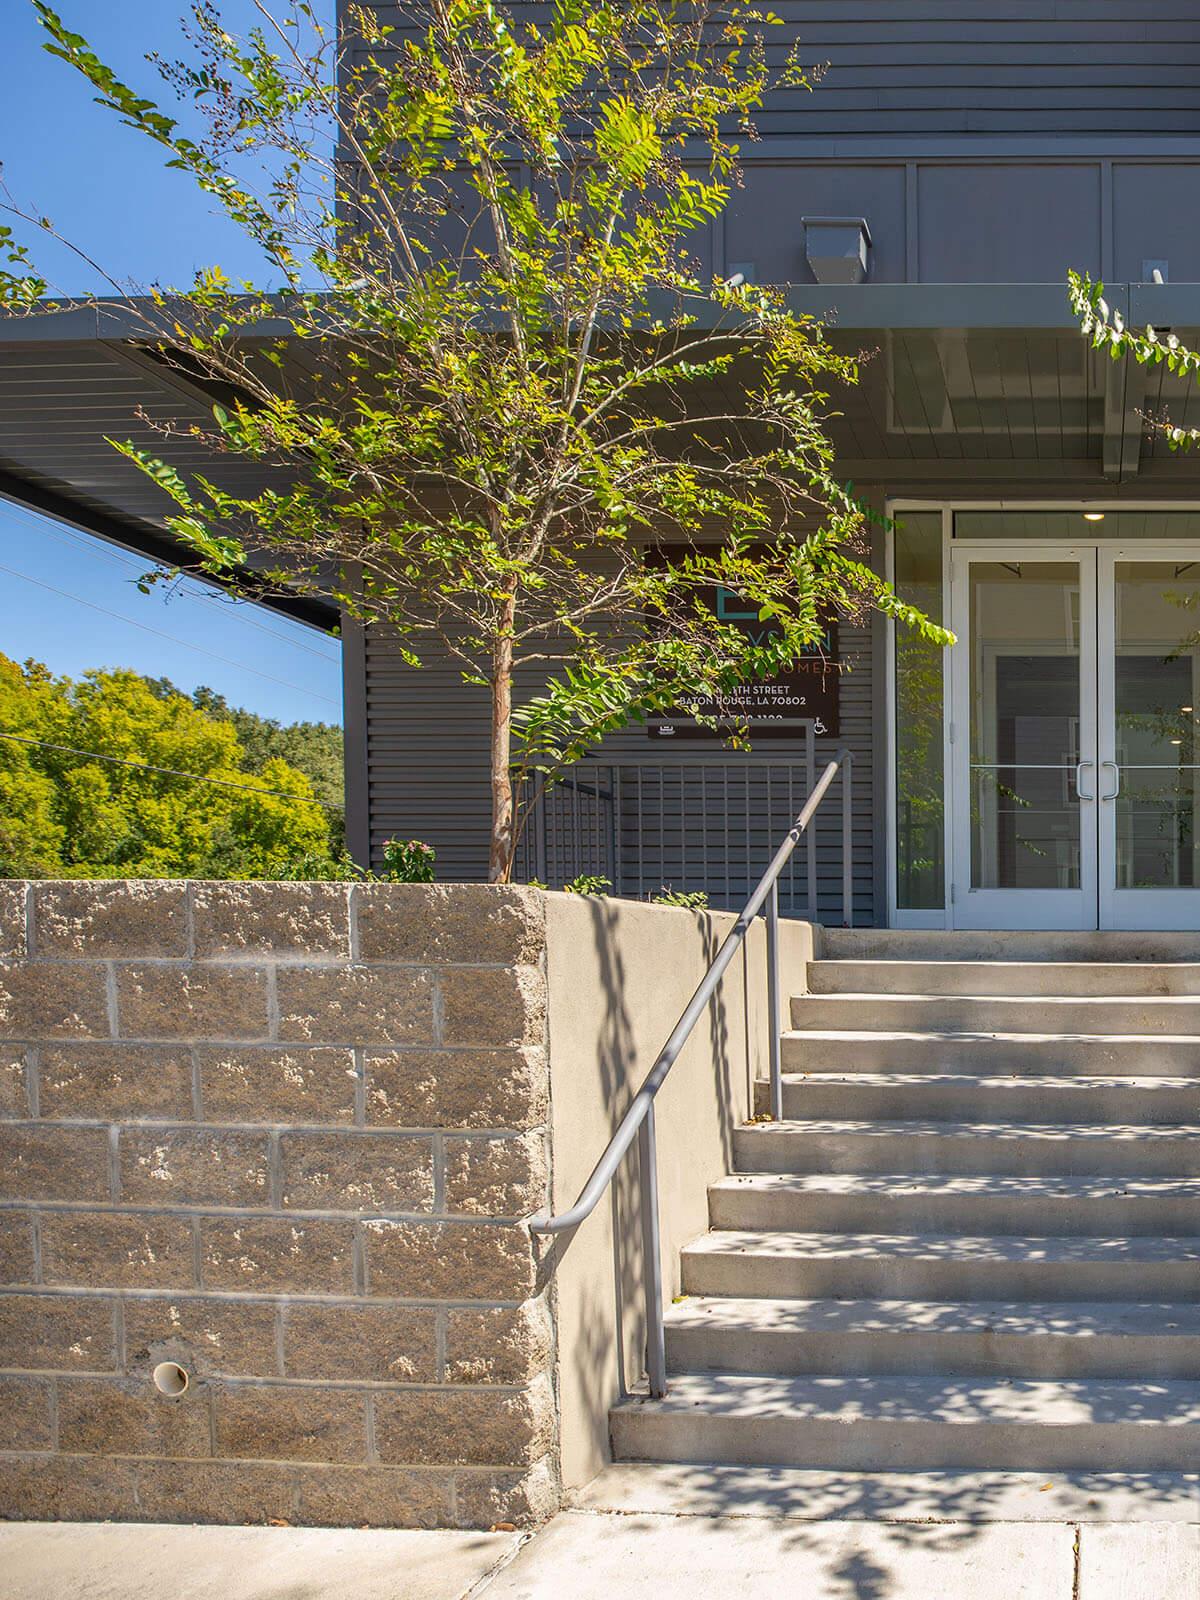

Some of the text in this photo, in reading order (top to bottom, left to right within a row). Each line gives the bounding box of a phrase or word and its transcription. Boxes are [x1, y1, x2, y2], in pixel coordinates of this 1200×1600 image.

[752, 685, 790, 695] STREET
[680, 696, 713, 705] BATON
[757, 697, 769, 705] LA
[771, 696, 806, 705] 70802
